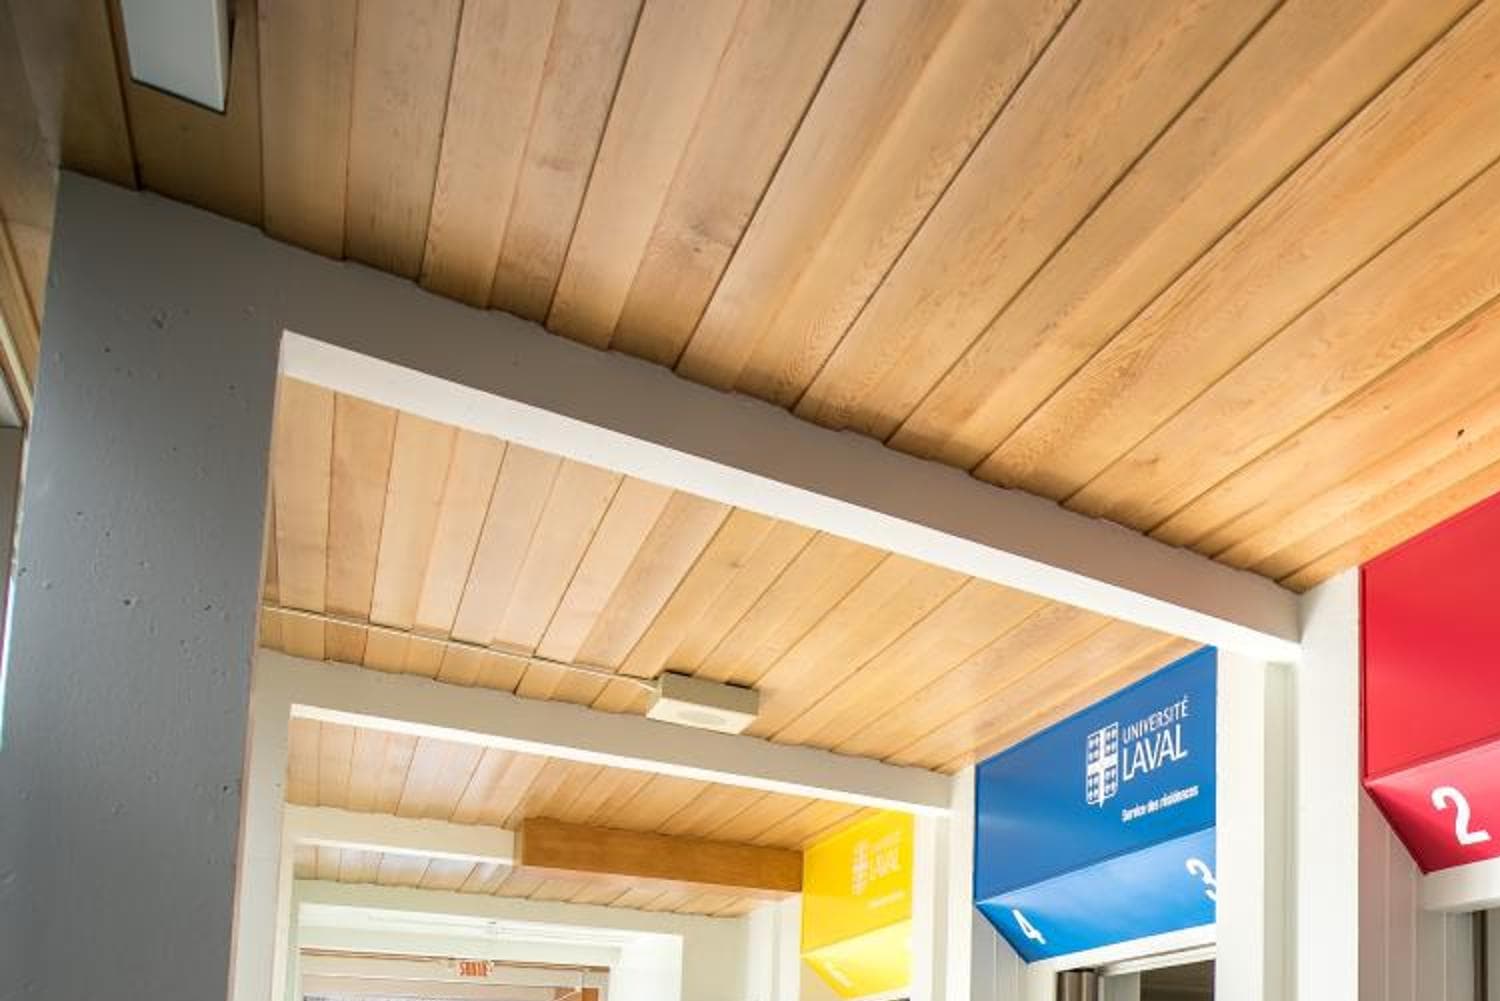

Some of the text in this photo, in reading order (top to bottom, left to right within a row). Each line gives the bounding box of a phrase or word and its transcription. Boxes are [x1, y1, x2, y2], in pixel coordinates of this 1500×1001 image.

[1123, 693, 1189, 744] UNIVERSITÉ
[1123, 723, 1188, 781] LAVAL
[1431, 786, 1491, 845] 2
[1013, 909, 1046, 944] 4
